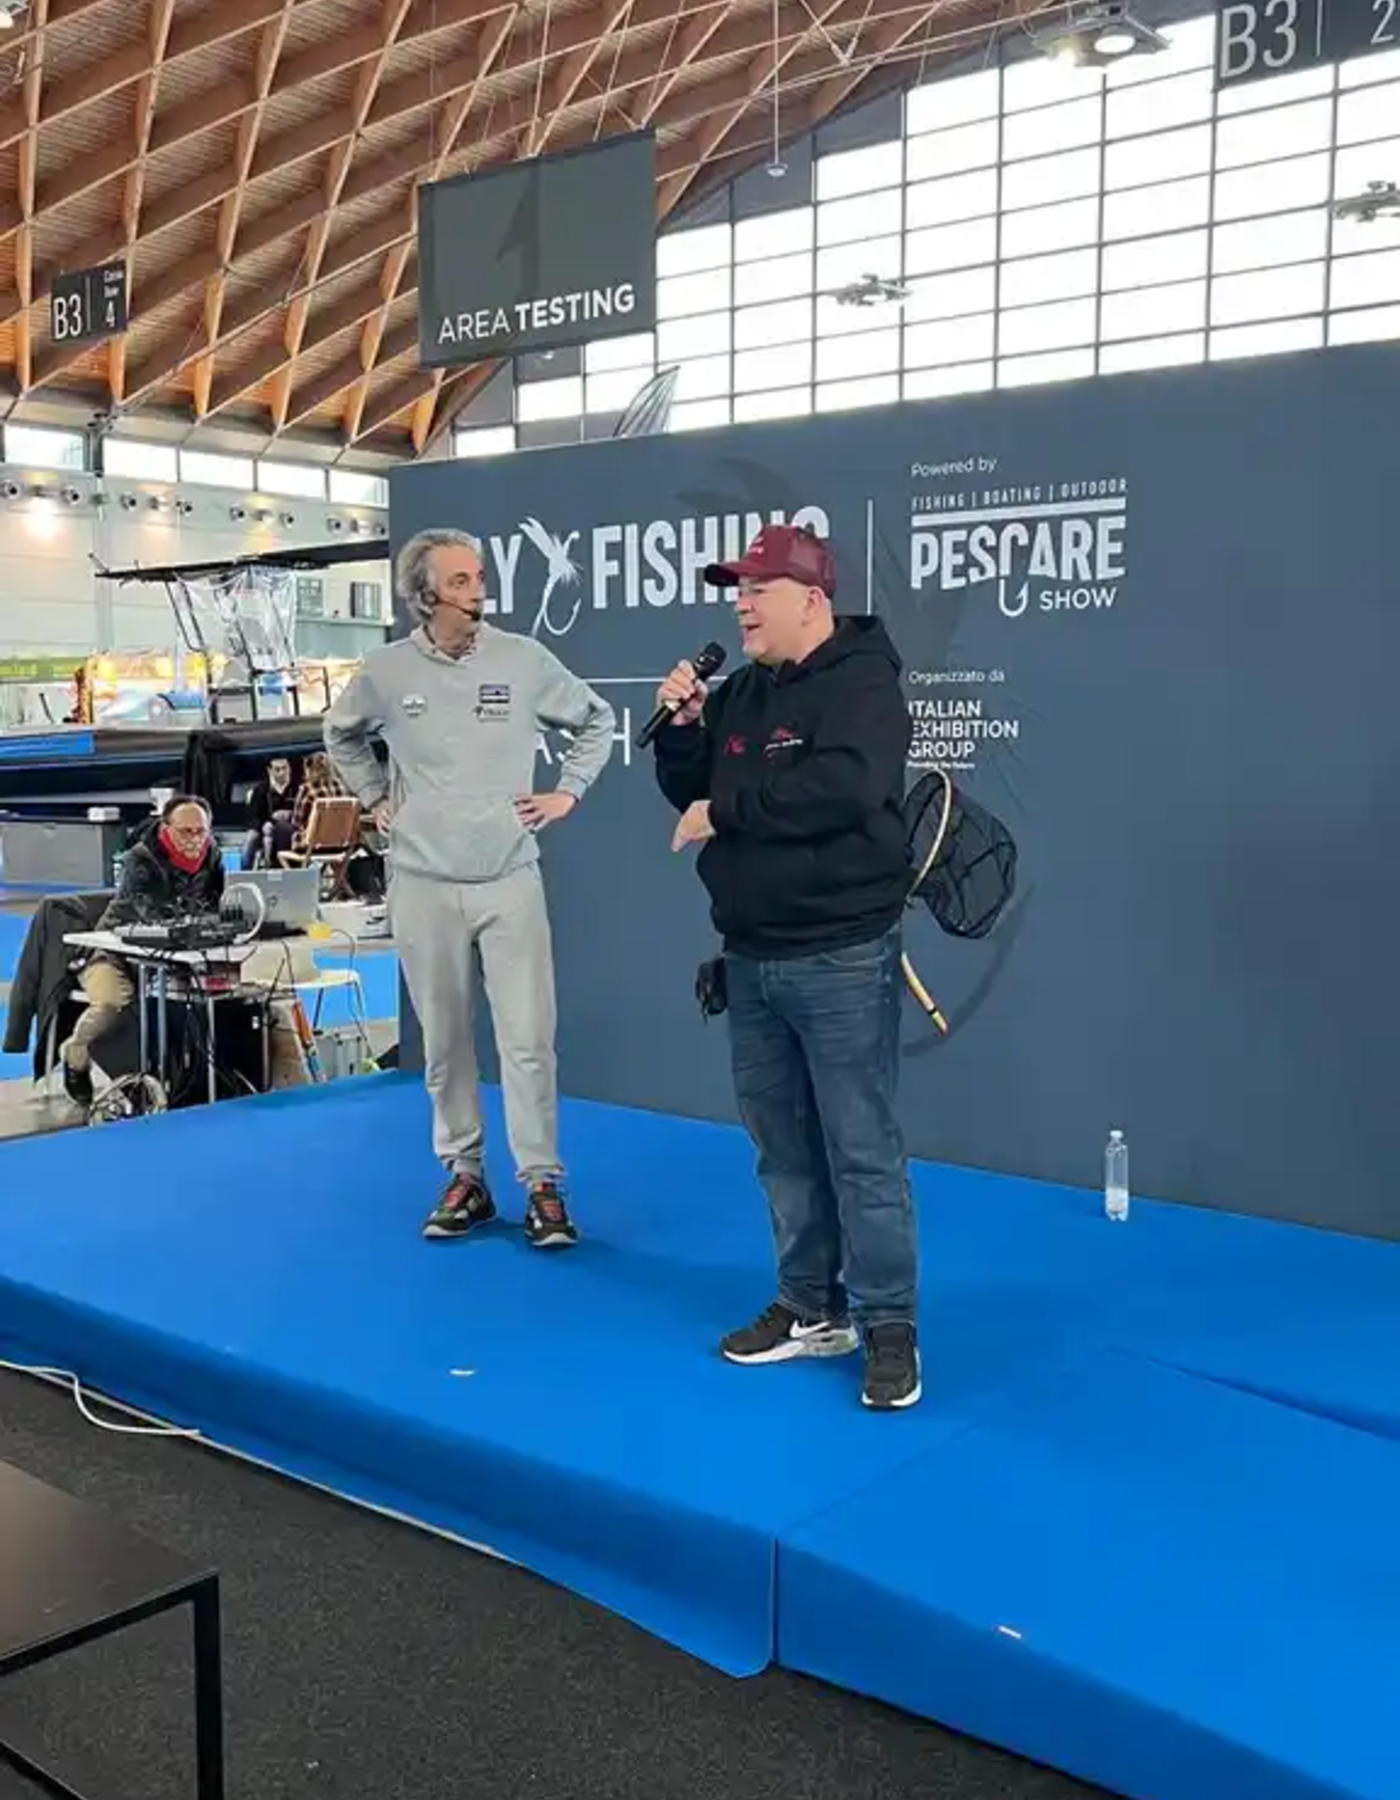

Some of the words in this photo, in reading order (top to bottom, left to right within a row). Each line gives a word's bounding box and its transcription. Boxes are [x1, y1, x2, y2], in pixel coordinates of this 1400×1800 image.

[1220, 0, 1297, 78] B3
[53, 294, 82, 339] B3
[437, 308, 511, 344] AREA
[515, 283, 635, 331] TESTING
[911, 459, 974, 477] Powered
[979, 456, 997, 473] by
[911, 493, 964, 511] FISHING
[984, 486, 1041, 505] BOATING
[1062, 478, 1127, 498] OUTDOOR
[910, 516, 1126, 590] PESCARE
[1039, 587, 1117, 611] SHOW
[908, 669, 985, 685] Organizzato
[989, 669, 1005, 683] da
[907, 700, 981, 718] ITALIAN
[912, 720, 1020, 739] EXHIBITION
[908, 741, 976, 758] GROUP
